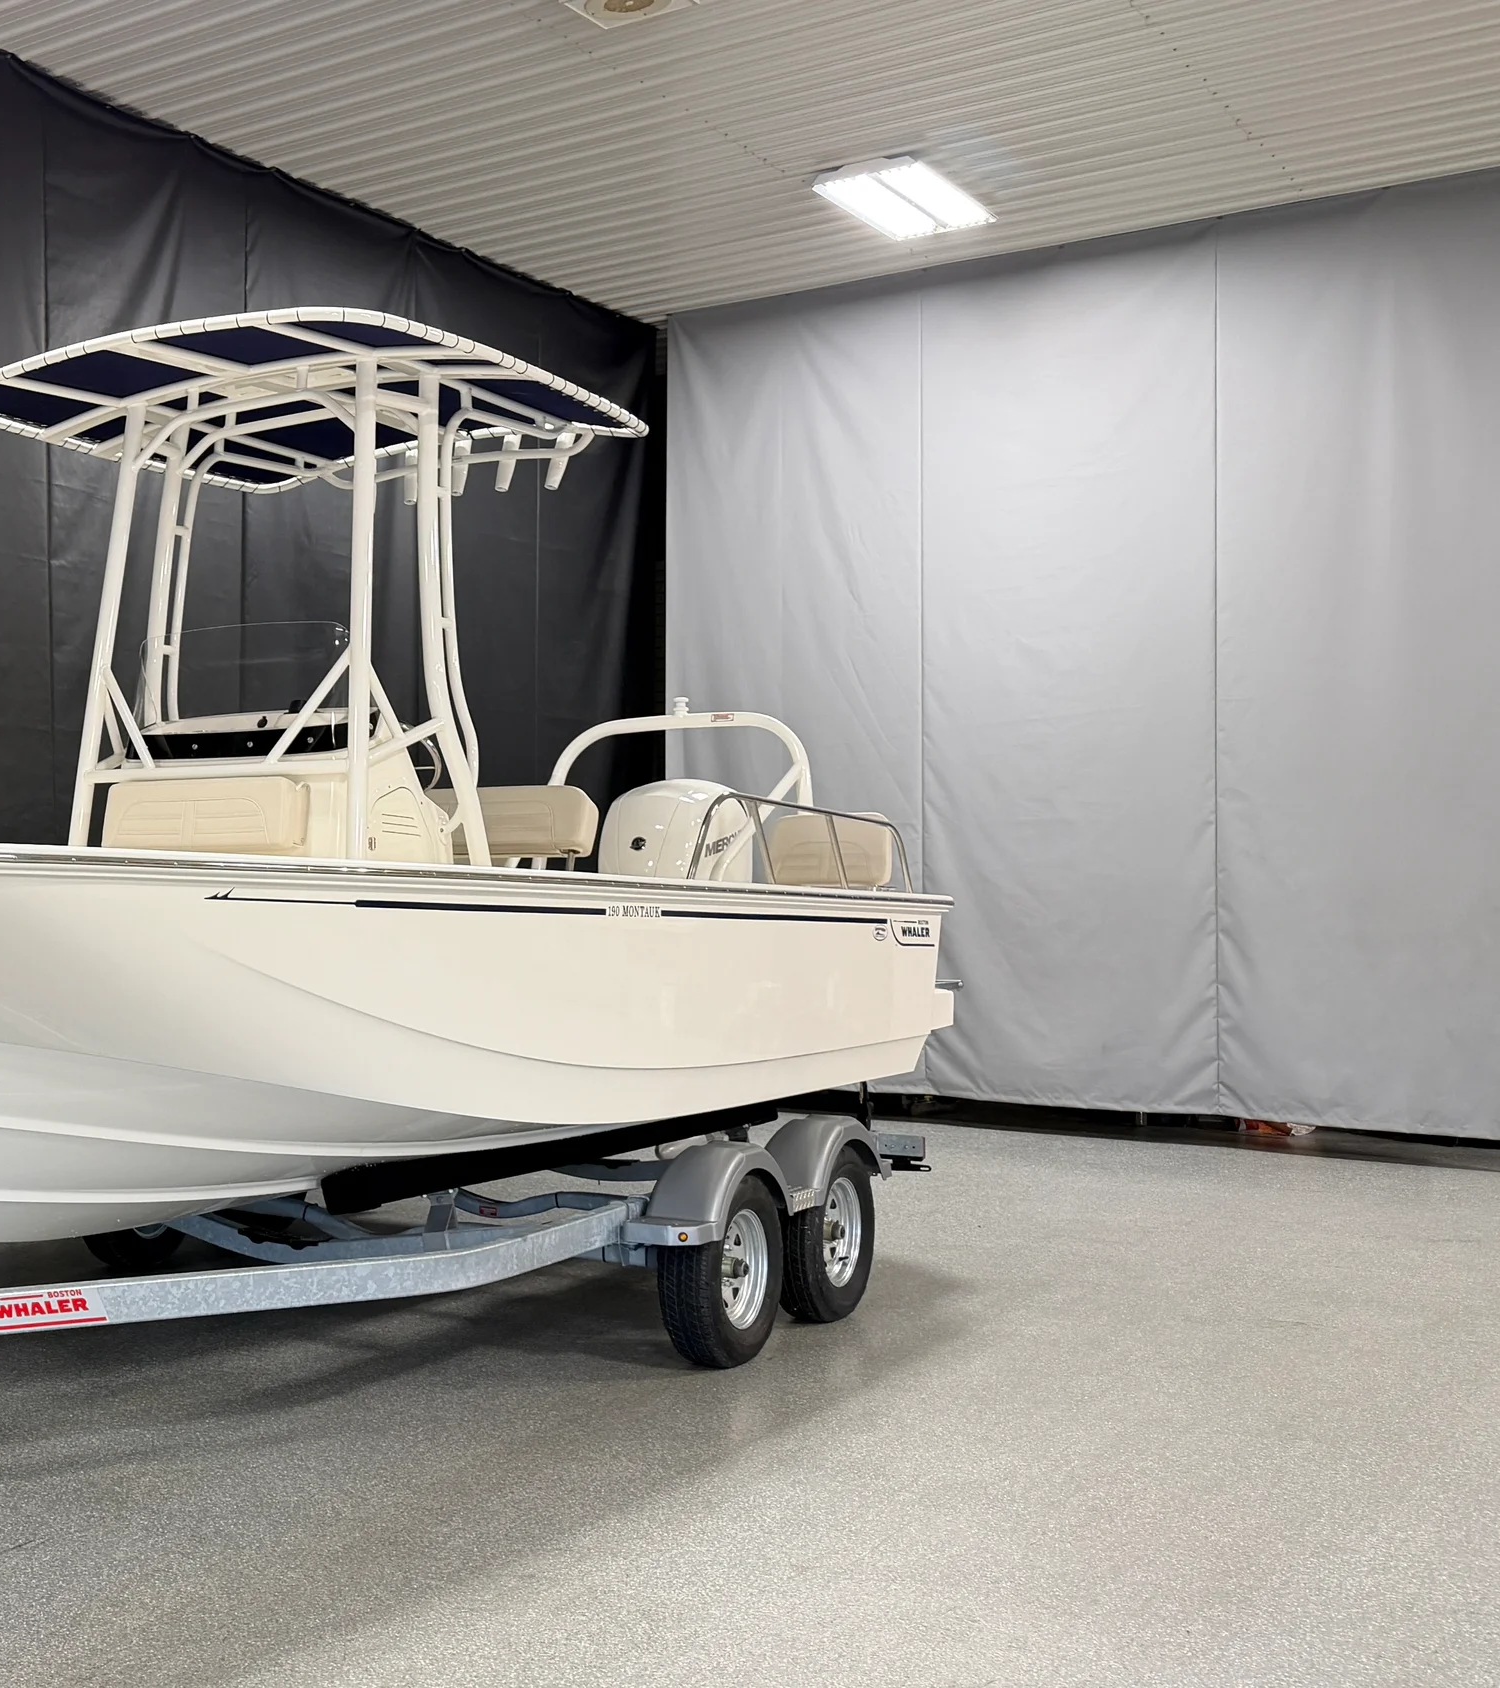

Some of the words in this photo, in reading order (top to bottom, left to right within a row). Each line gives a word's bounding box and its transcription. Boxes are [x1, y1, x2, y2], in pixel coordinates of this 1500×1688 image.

[608, 906, 620, 917] 190
[622, 905, 661, 918] MONTAUK
[901, 926, 930, 938] WHALER
[47, 1289, 83, 1298] BOSTON
